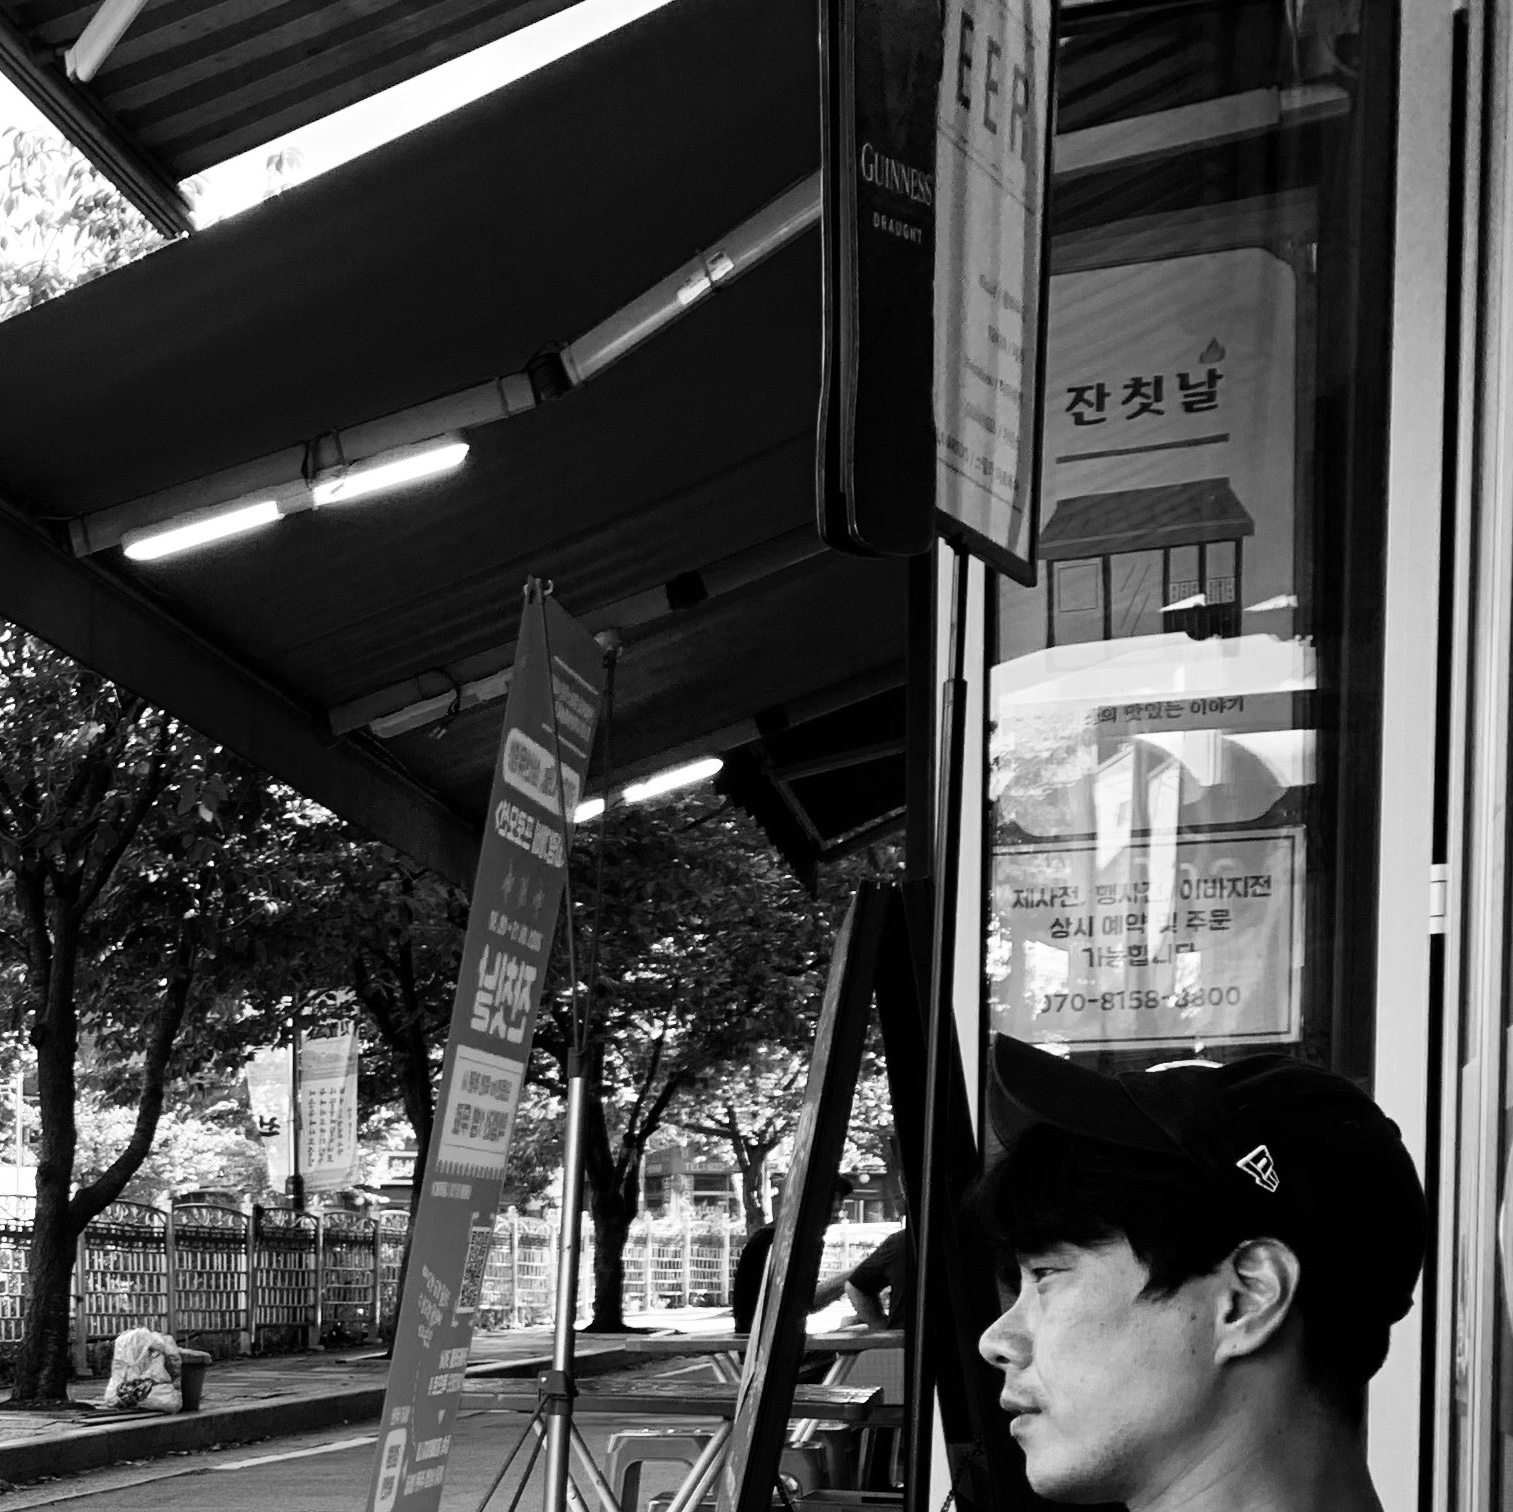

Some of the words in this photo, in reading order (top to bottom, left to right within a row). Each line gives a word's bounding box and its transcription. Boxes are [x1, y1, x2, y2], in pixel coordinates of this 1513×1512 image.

[958, 10, 1029, 163] EER
[861, 143, 934, 206] GUINNESS
[872, 211, 923, 245] DRAUGHT
[1064, 368, 1225, 425] 잔칫날
[1190, 695, 1245, 717] 이야기
[1179, 874, 1273, 901] 이바지전
[1050, 915, 1095, 939] 상시
[1102, 912, 1148, 936] 예약
[1186, 908, 1232, 932] 주문
